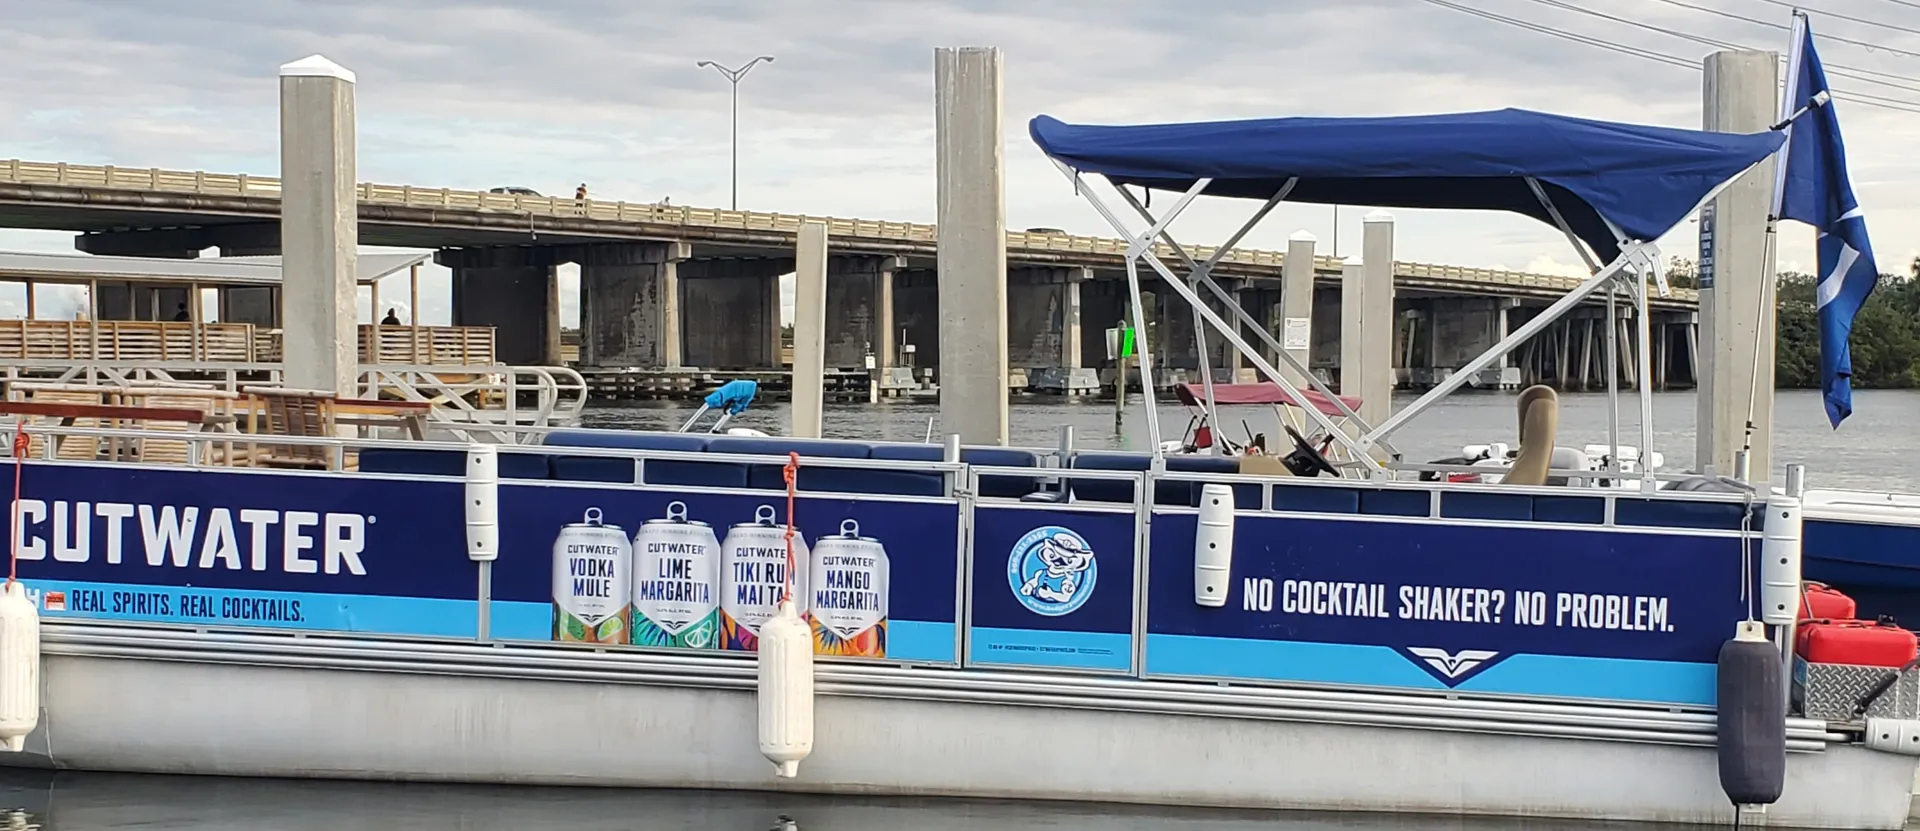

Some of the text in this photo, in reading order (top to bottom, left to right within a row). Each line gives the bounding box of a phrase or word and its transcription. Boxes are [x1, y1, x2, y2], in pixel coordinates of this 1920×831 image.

[11, 499, 367, 575] CUTWATER
[567, 544, 618, 555] CUTWATER
[647, 543, 705, 555] CUTWATER
[736, 547, 788, 559] CUTWATE
[569, 558, 615, 578] VODKA
[659, 557, 692, 579] LIME
[822, 555, 875, 567] CUTWATER
[733, 562, 760, 582] TIKI
[826, 569, 870, 590] MANGO
[573, 578, 610, 597] MULE
[640, 580, 709, 603] MARGARITA
[737, 584, 763, 605] MAI
[72, 589, 305, 622] REAL SPIRITS. REAL COCKTAILS.
[816, 590, 879, 611] MARGARITA
[1243, 577, 1675, 632] NO COCKTAIL SHAKER? NO PROBLEM.
